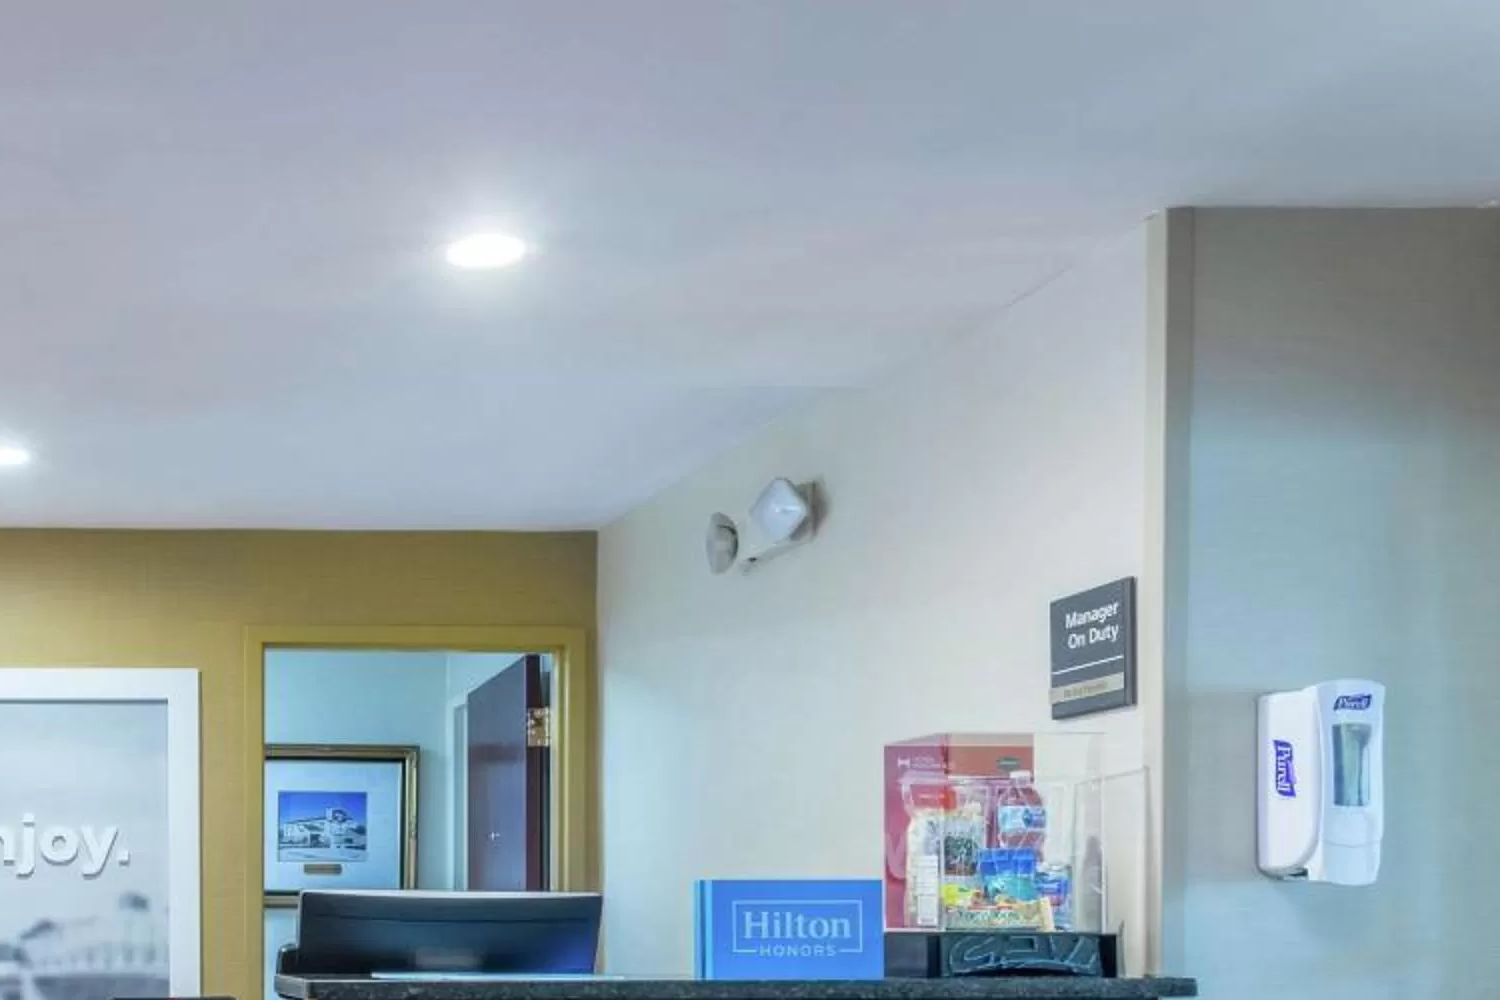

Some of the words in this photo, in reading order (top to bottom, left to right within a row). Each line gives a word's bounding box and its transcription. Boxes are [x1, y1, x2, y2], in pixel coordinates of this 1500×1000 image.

[1065, 601, 1119, 629] Manager
[1067, 633, 1086, 649] On
[1089, 624, 1119, 645] Duty
[743, 911, 852, 939] Hilton
[759, 944, 837, 957] HONORS
